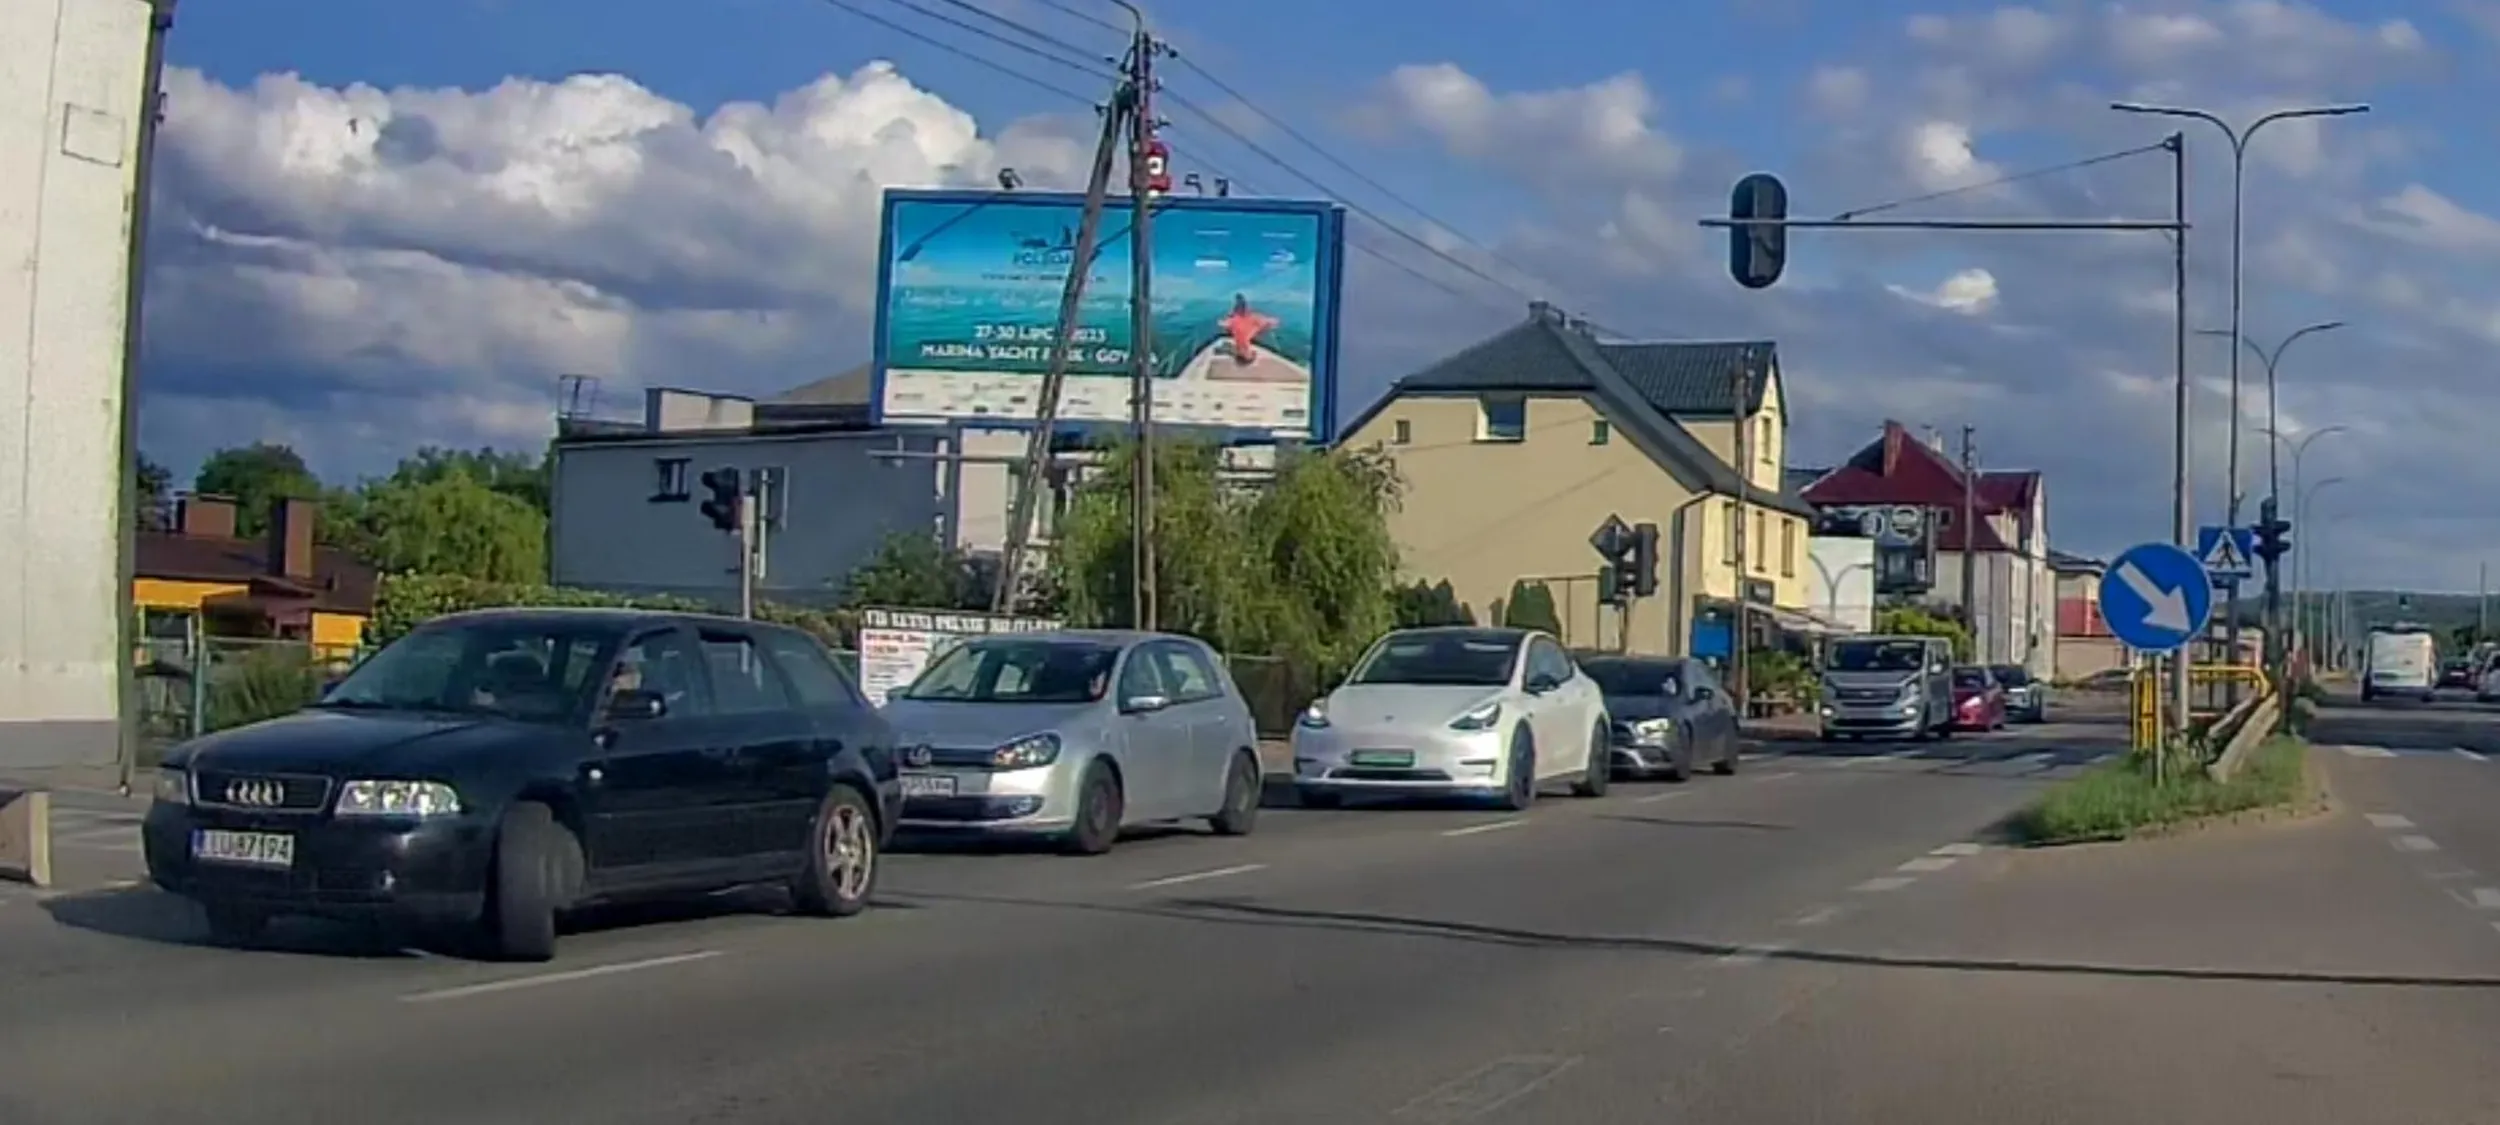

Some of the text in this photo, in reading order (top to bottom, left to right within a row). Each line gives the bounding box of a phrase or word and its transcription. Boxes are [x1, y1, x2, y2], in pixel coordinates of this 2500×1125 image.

[1019, 327, 1060, 341] LIPC
[922, 344, 984, 359] MARINA
[987, 346, 1039, 361] YACHT
